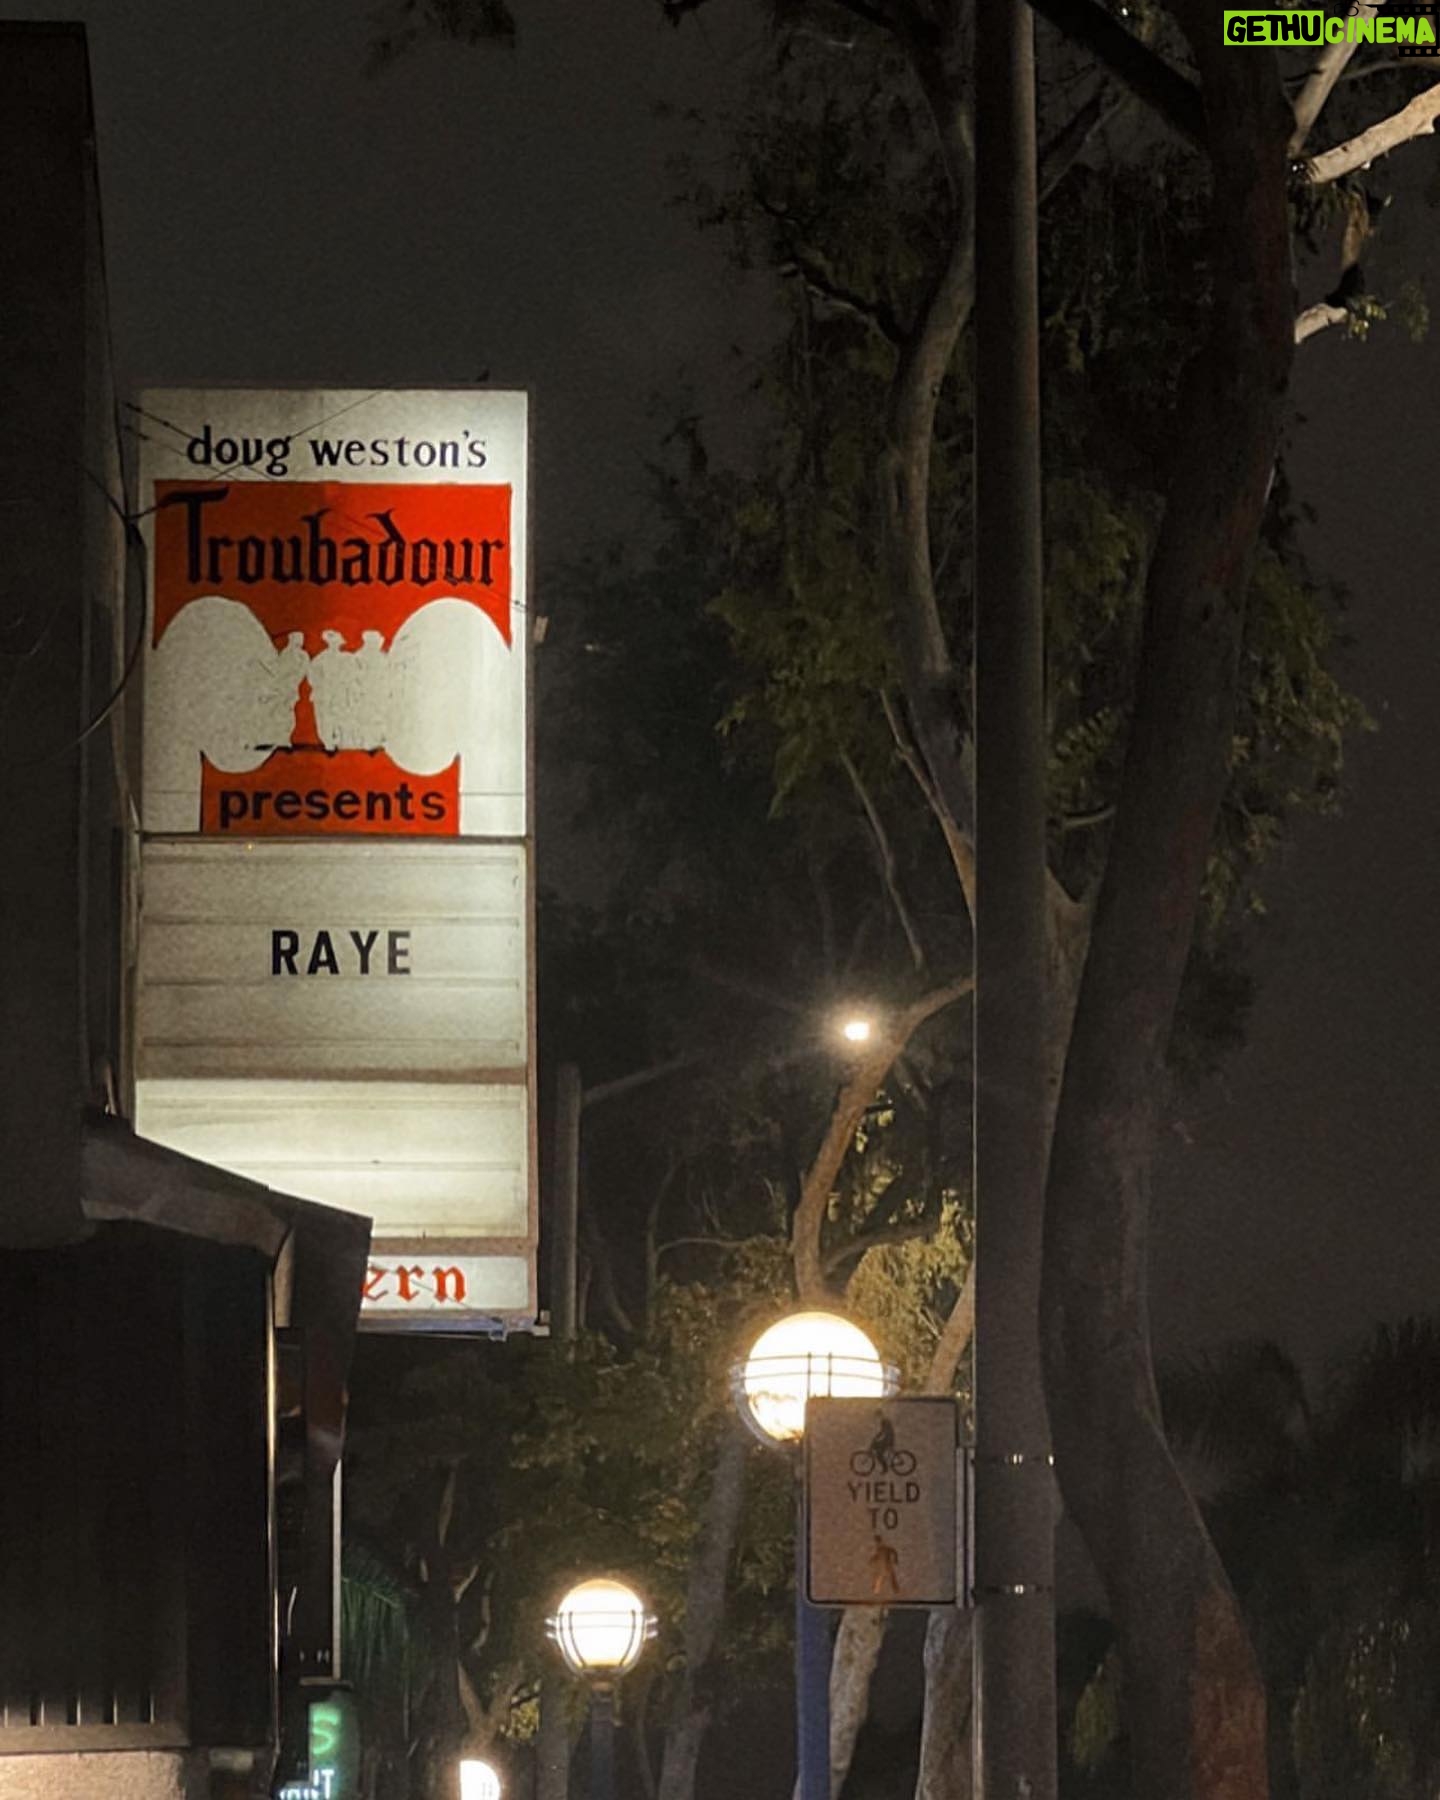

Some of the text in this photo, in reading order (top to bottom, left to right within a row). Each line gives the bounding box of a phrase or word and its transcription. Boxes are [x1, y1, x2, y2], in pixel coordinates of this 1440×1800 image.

[187, 425, 488, 475] doug weston's
[162, 486, 505, 587] Troubadour
[219, 782, 447, 829] presents
[271, 929, 412, 976] RAYE
[847, 1481, 921, 1504] YIELD
[867, 1507, 899, 1530] TO
